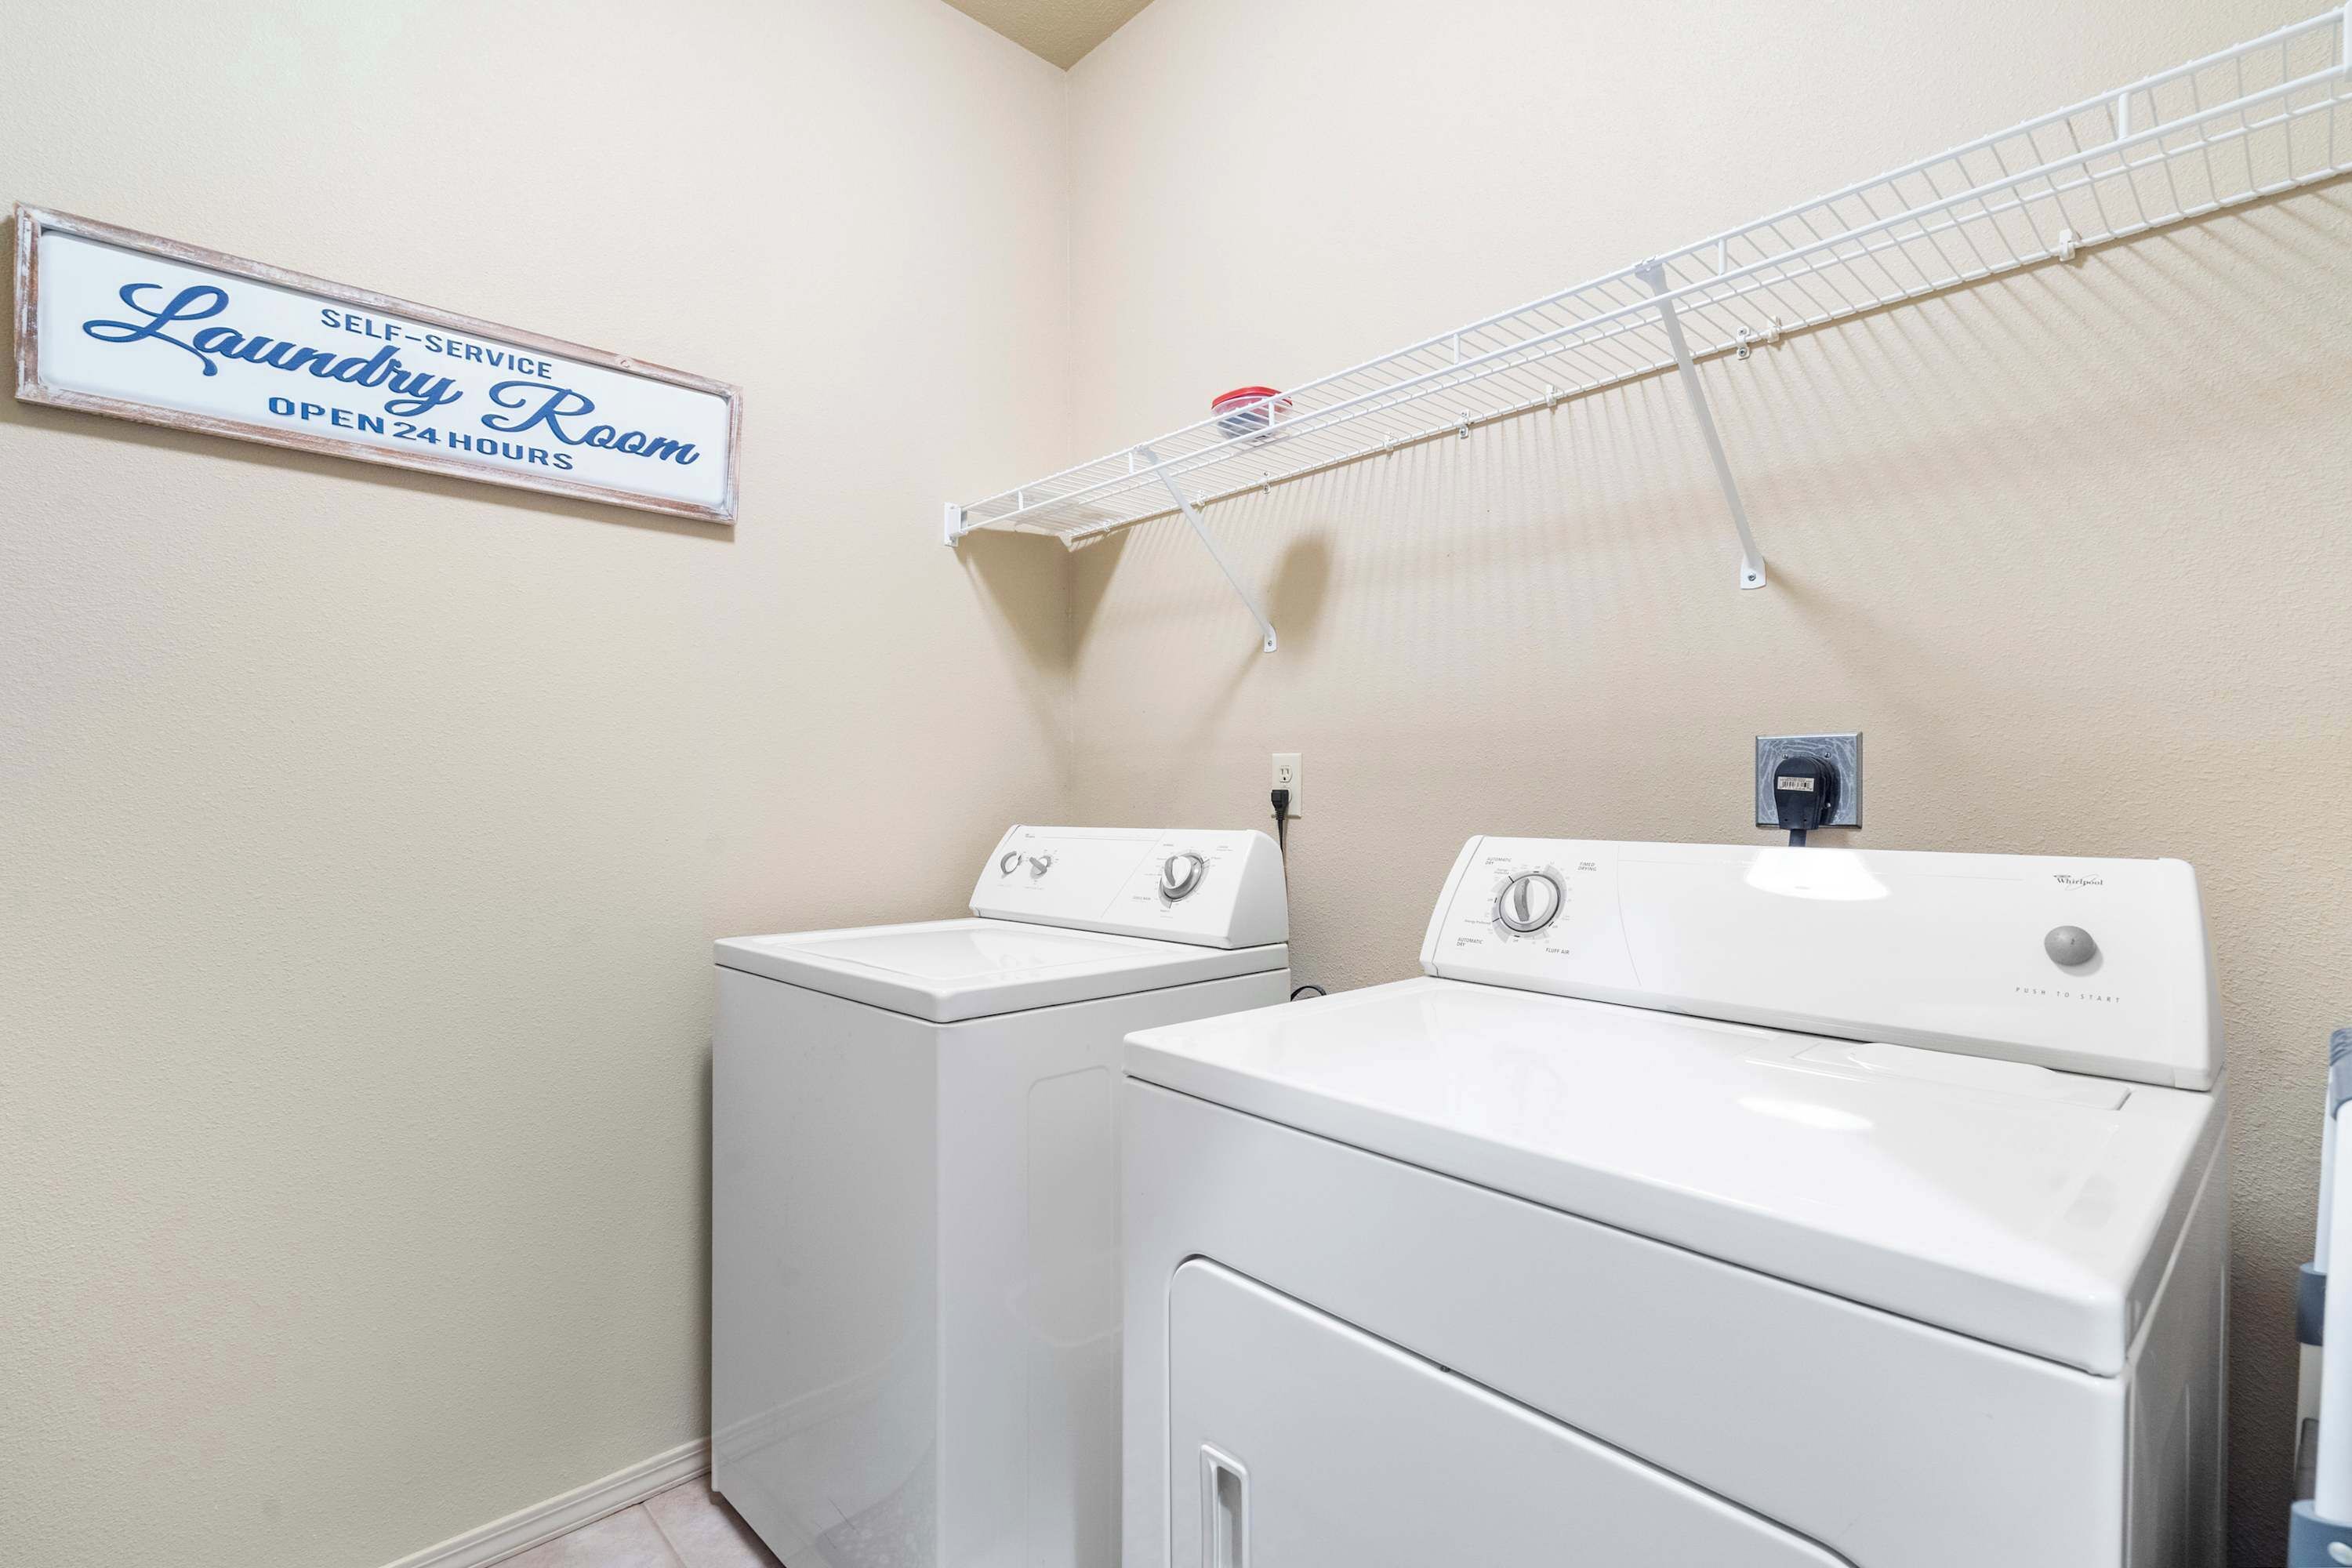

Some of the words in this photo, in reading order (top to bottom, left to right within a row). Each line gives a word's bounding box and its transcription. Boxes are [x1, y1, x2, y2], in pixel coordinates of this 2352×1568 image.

[321, 309, 554, 380] SELF-SERVICE
[82, 282, 463, 418] Laundry
[480, 380, 701, 465] Room
[267, 396, 386, 436] OPEN
[393, 421, 442, 446] 24
[448, 431, 574, 471] HOURS
[2056, 877, 2104, 887] Whirlpool
[1457, 936, 1483, 945] AUTOMATIC
[2016, 986, 2046, 996] PUSH
[2079, 993, 2121, 1004] START
